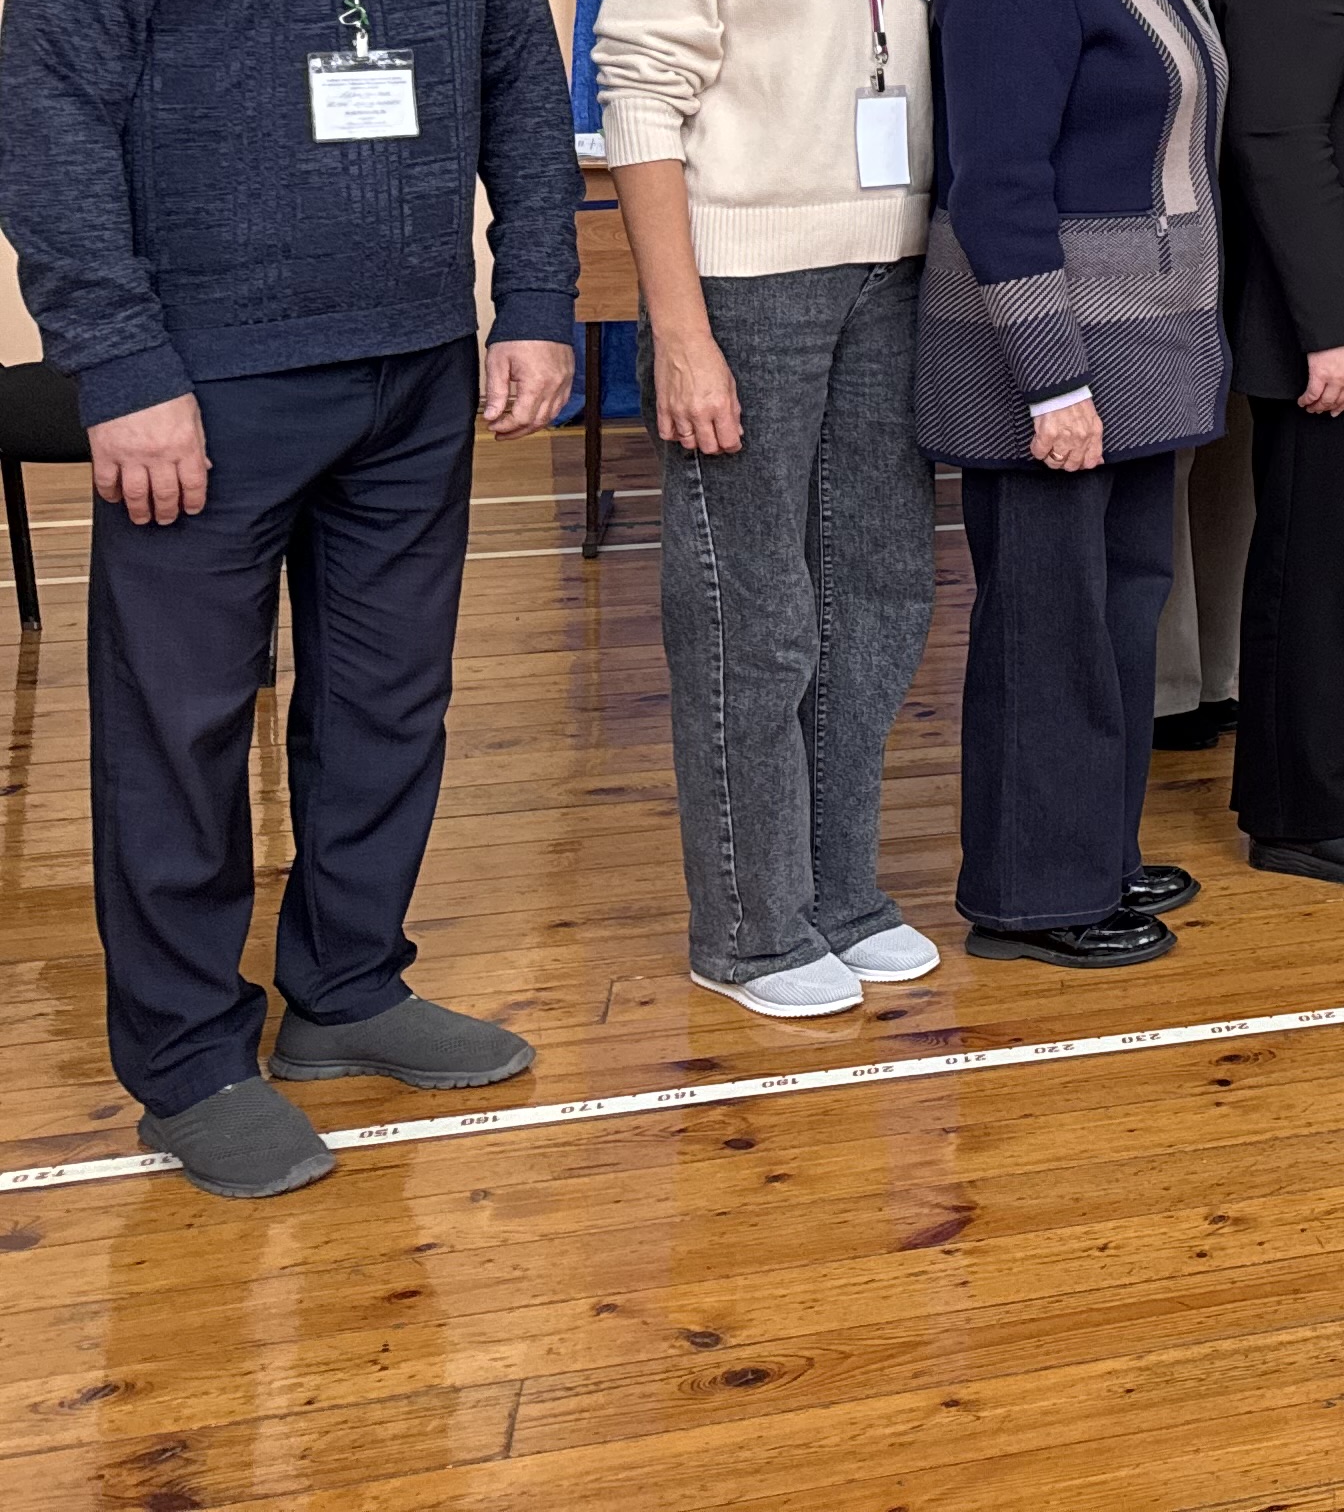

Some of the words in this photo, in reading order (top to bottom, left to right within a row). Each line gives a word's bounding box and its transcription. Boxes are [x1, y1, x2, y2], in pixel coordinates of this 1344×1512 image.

[359, 1128, 399, 1138] 150
[560, 1102, 604, 1113] 170
[761, 1077, 799, 1088] 190
[852, 1065, 895, 1076] 200
[945, 1054, 986, 1064] 210
[1034, 1043, 1075, 1054] 220
[1121, 1033, 1161, 1044] 230
[1210, 1022, 1249, 1033] 240
